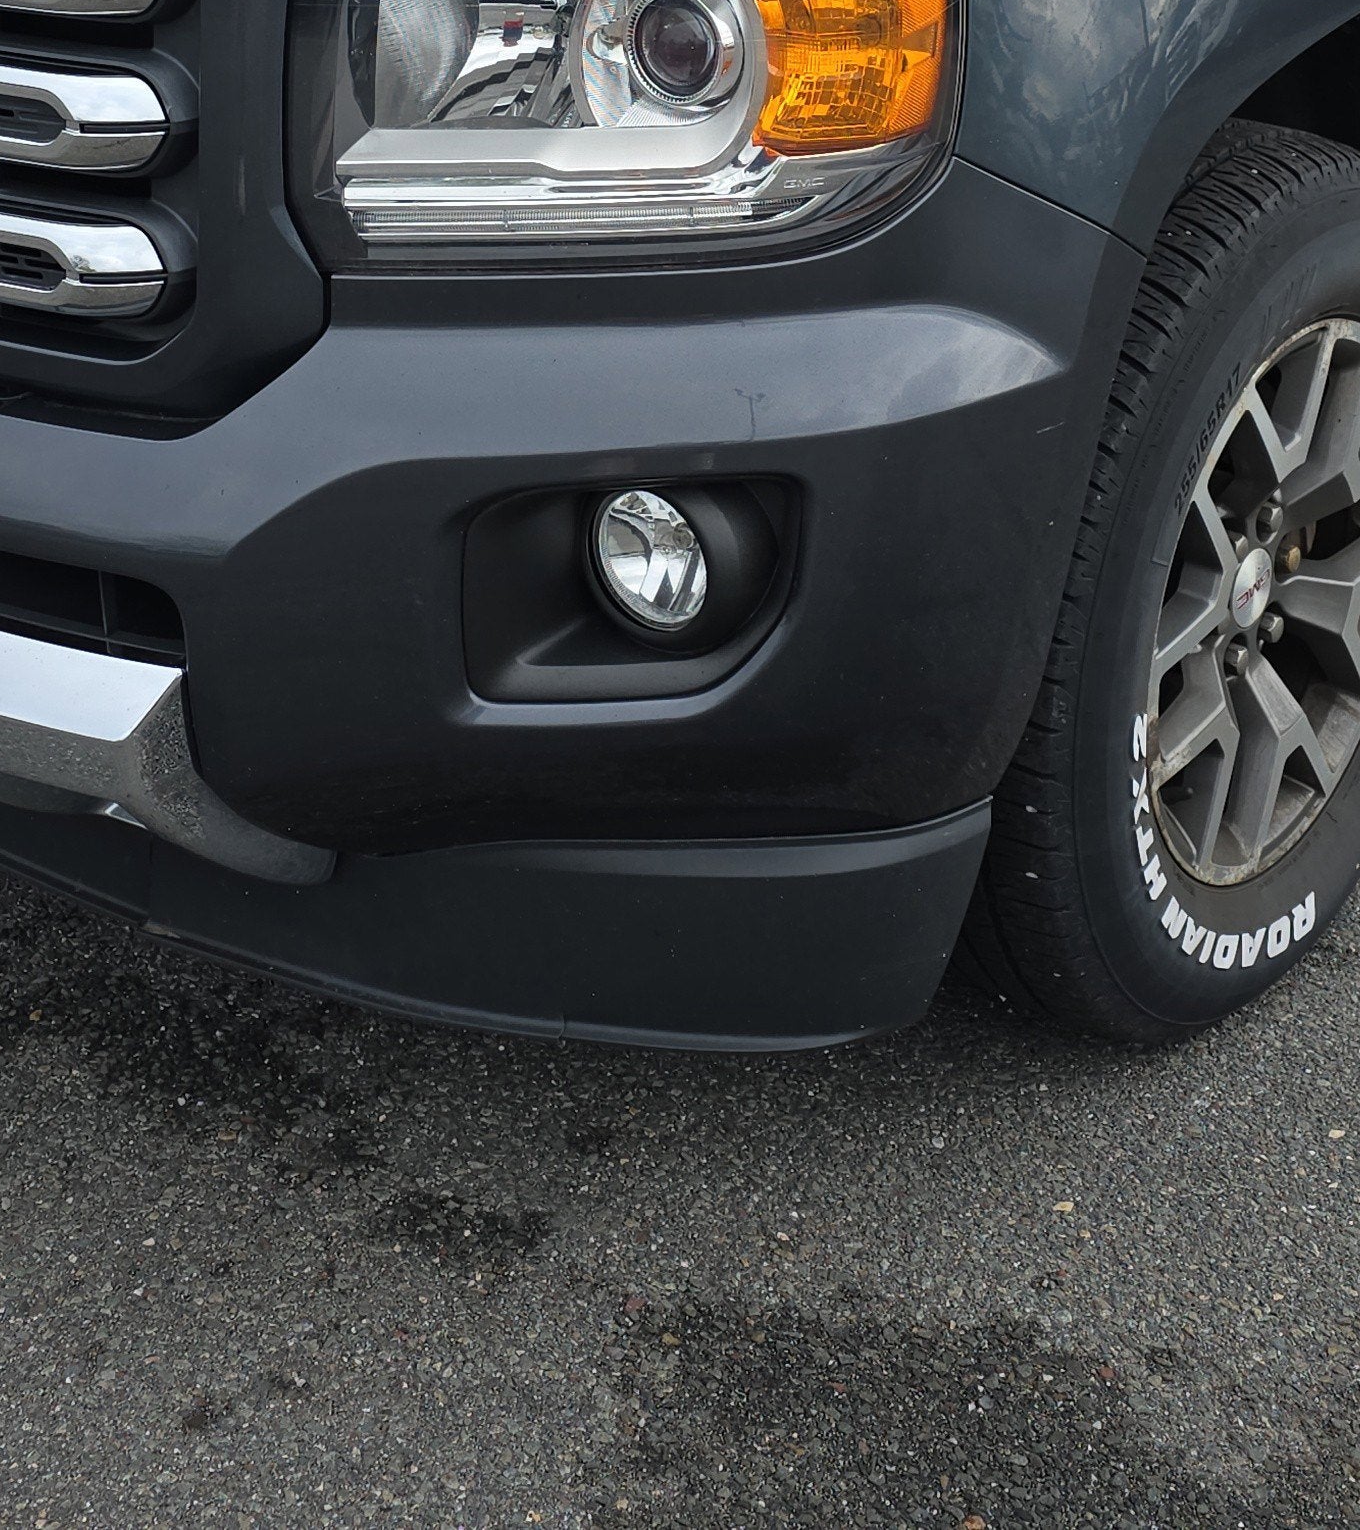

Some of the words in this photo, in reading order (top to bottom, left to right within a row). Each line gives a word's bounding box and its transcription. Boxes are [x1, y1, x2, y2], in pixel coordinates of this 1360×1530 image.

[783, 176, 826, 189] GMC
[1174, 361, 1241, 517] 255/65R17
[1132, 767, 1168, 901] HTX
[1161, 890, 1316, 970] ROADIAN
